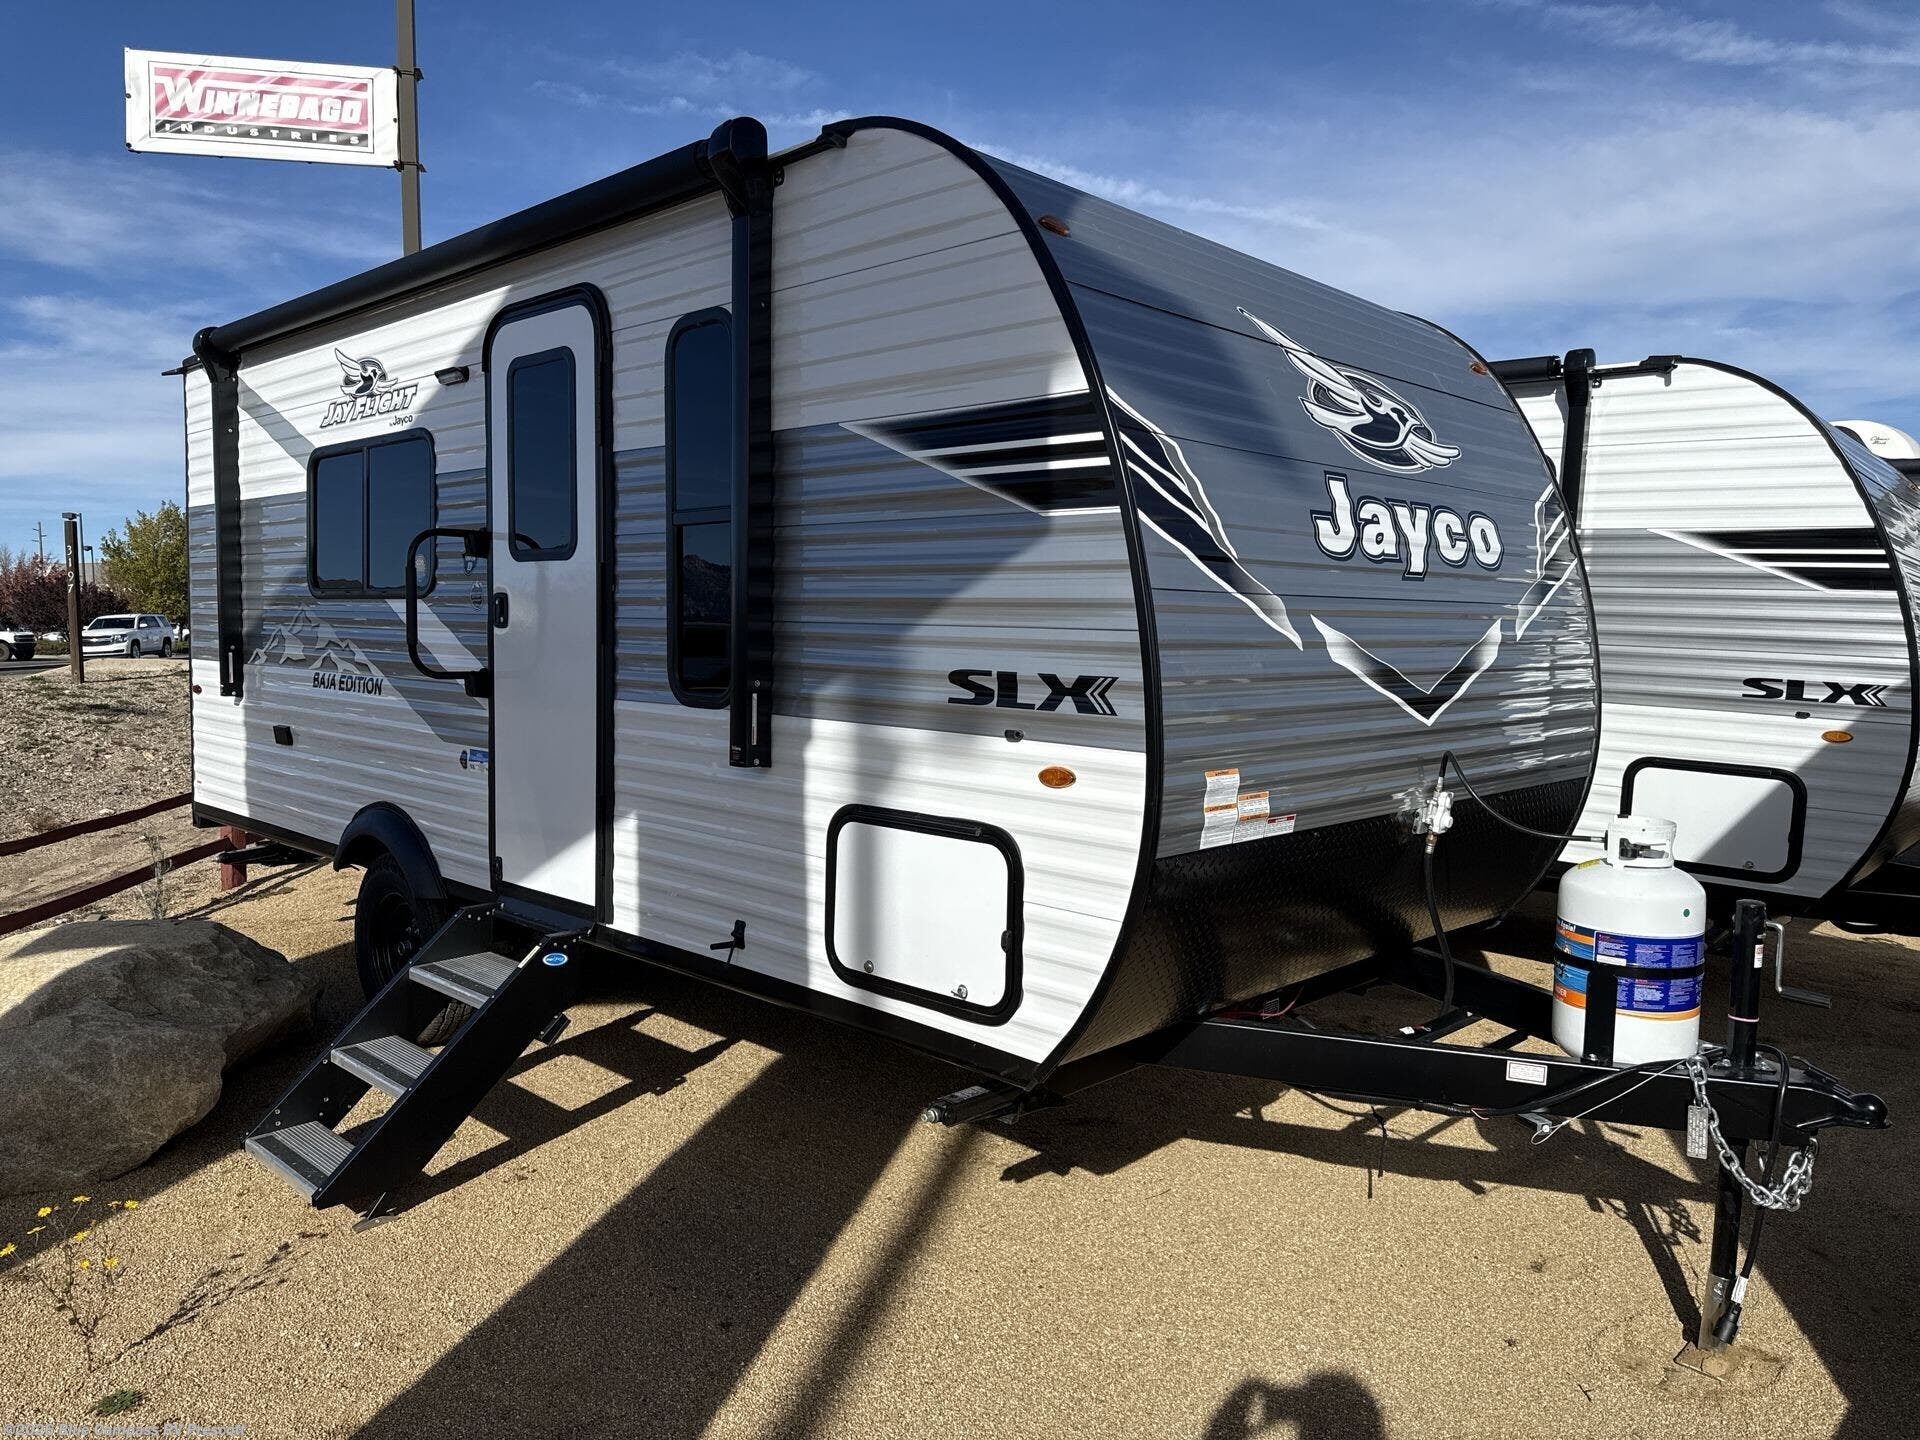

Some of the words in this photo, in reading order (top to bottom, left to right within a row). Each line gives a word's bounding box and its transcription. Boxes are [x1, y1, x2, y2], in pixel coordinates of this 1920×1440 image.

[153, 76, 363, 124] WINNEBAGO
[163, 122, 362, 146] INDUSTRIES
[348, 382, 419, 423] FLIGHT
[392, 414, 414, 427] Jayco
[1309, 470, 1504, 582] Jayco
[312, 671, 337, 691] BAJA
[338, 674, 384, 696] EDITION
[947, 668, 1120, 717] SLX
[1741, 677, 1890, 708] SLX
